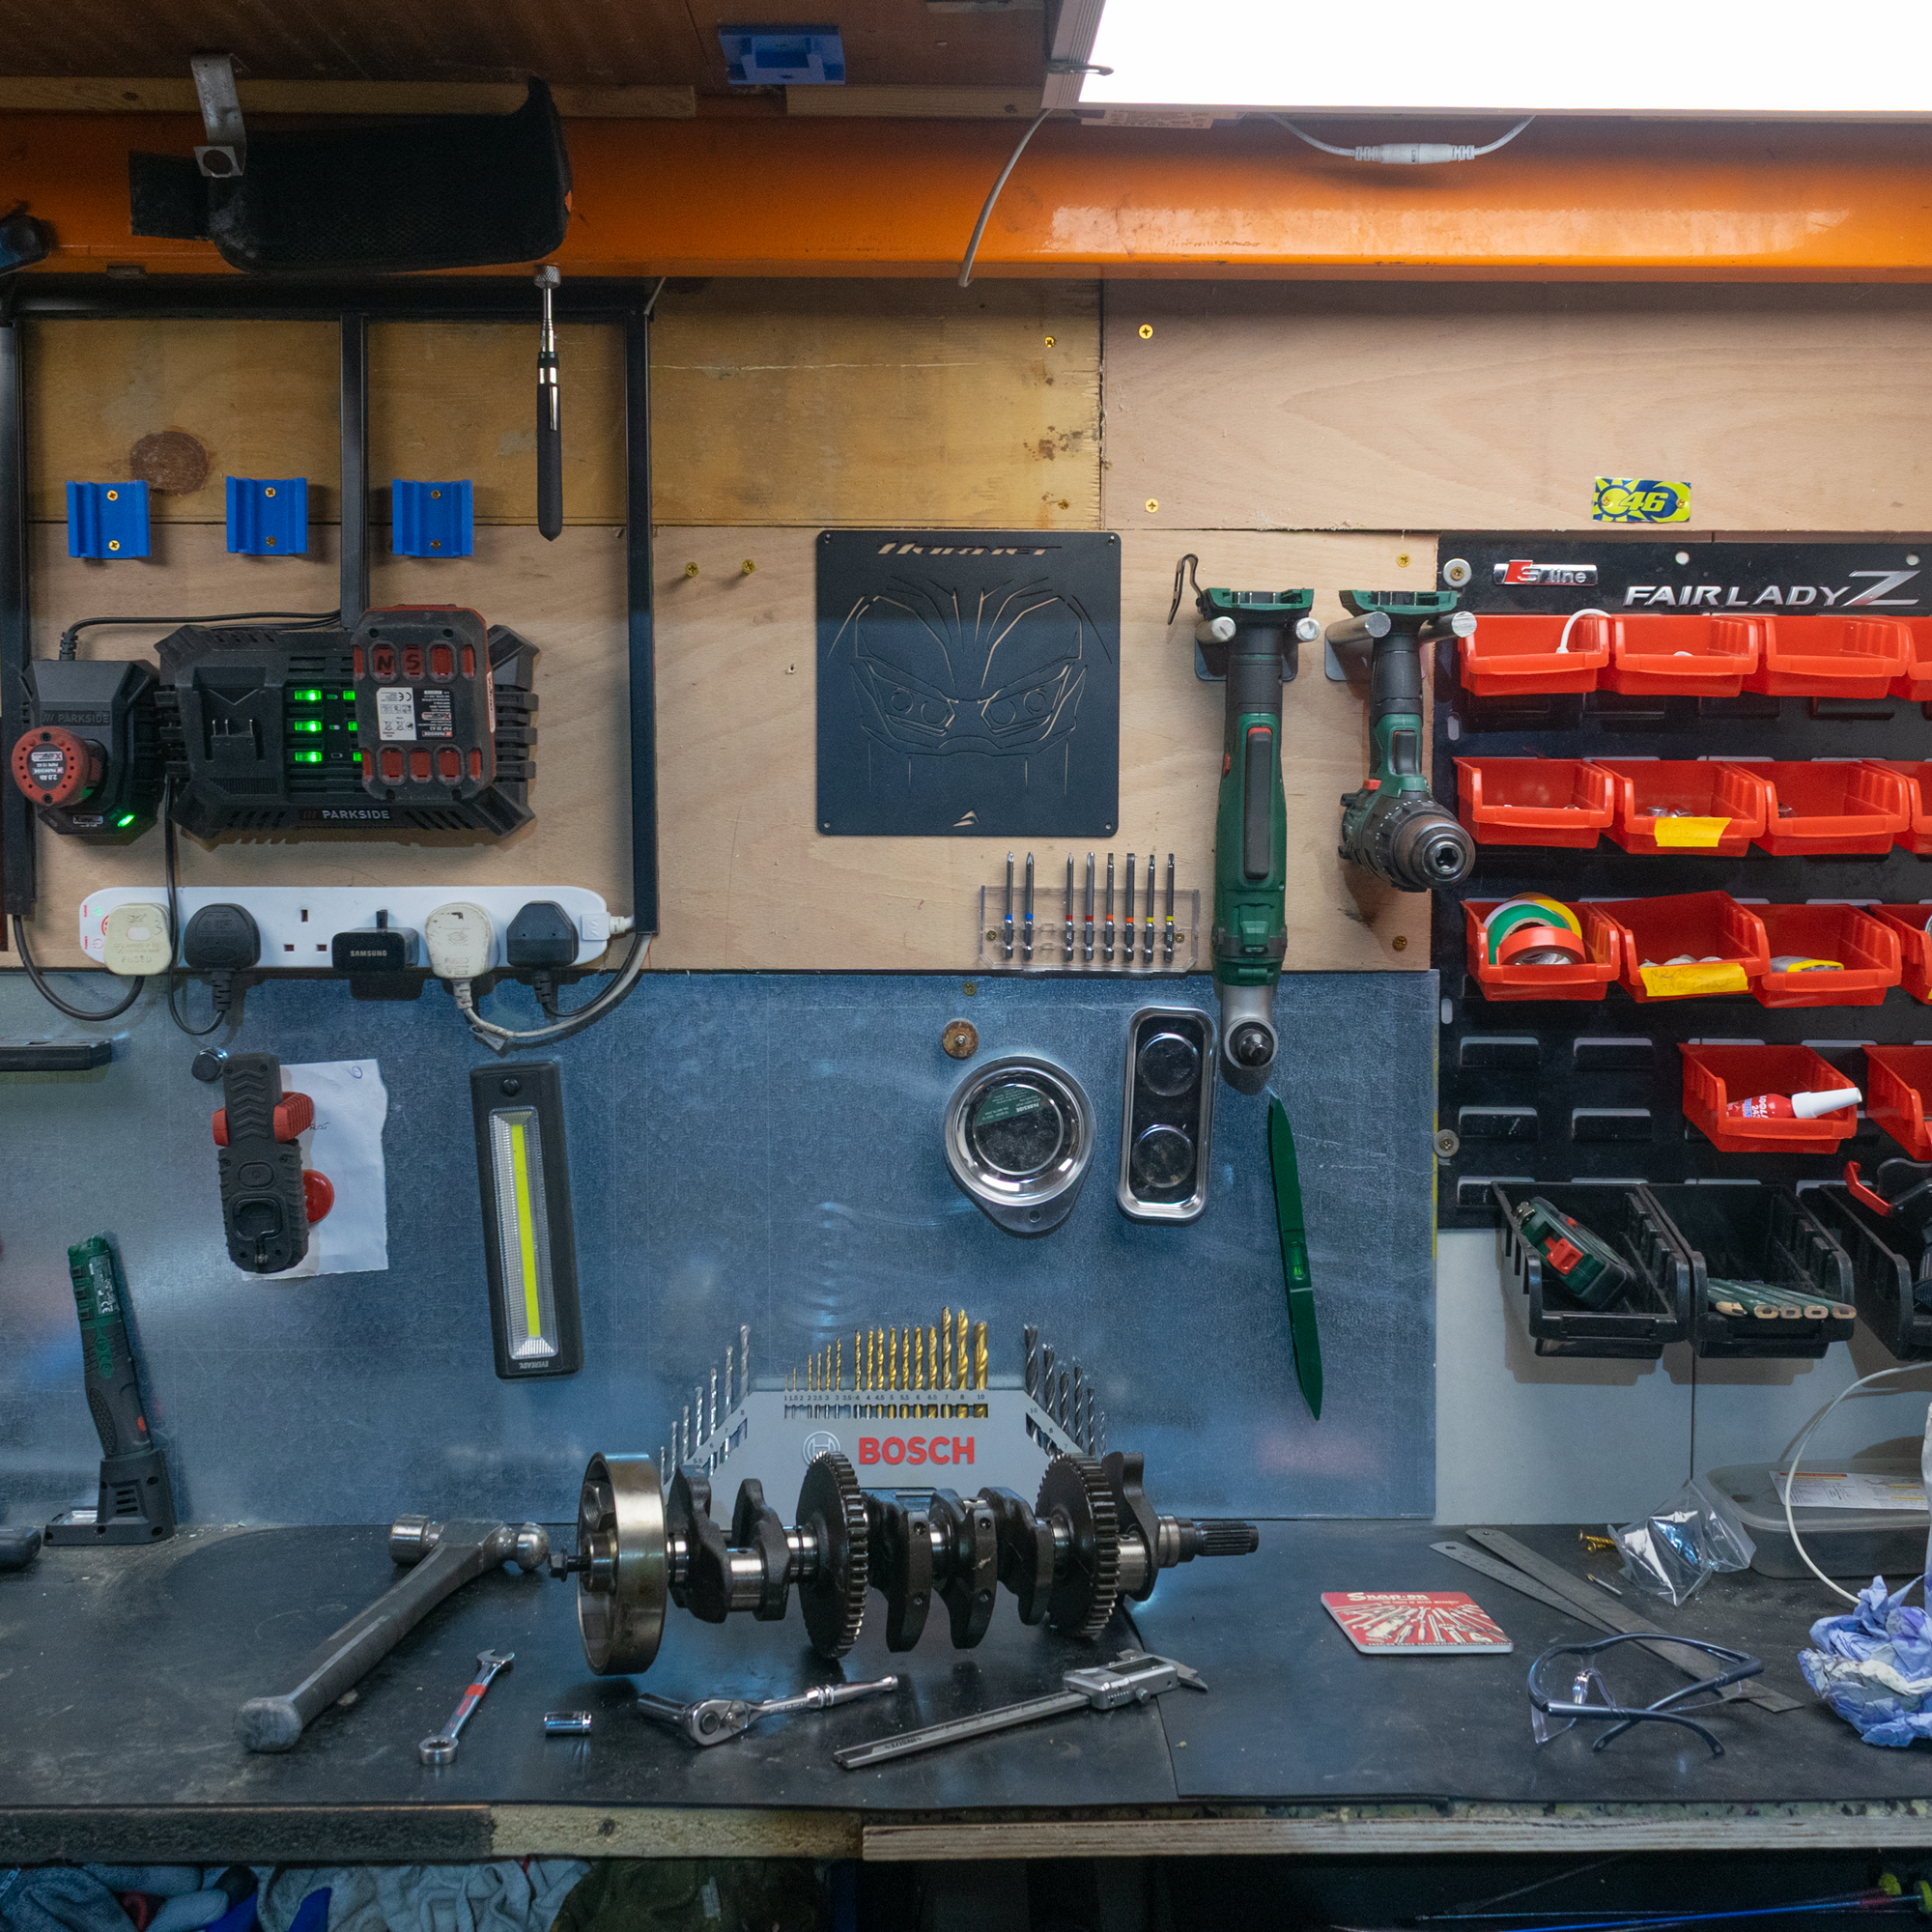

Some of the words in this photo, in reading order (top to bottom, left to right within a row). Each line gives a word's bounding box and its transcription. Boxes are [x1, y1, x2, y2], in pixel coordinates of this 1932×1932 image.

[1620, 491, 1669, 513] 46
[1518, 565, 1543, 582] S
[1549, 566, 1586, 584] line
[1623, 584, 1851, 607] FAIRLADY
[1841, 570, 1921, 608] Z
[59, 714, 109, 723] PARKSIDE
[322, 810, 390, 819] PARKSIDE
[1016, 1102, 1039, 1113] PARKSIDE
[859, 1435, 975, 1464] BOSCH
[1347, 1592, 1430, 1601] Snap-on
